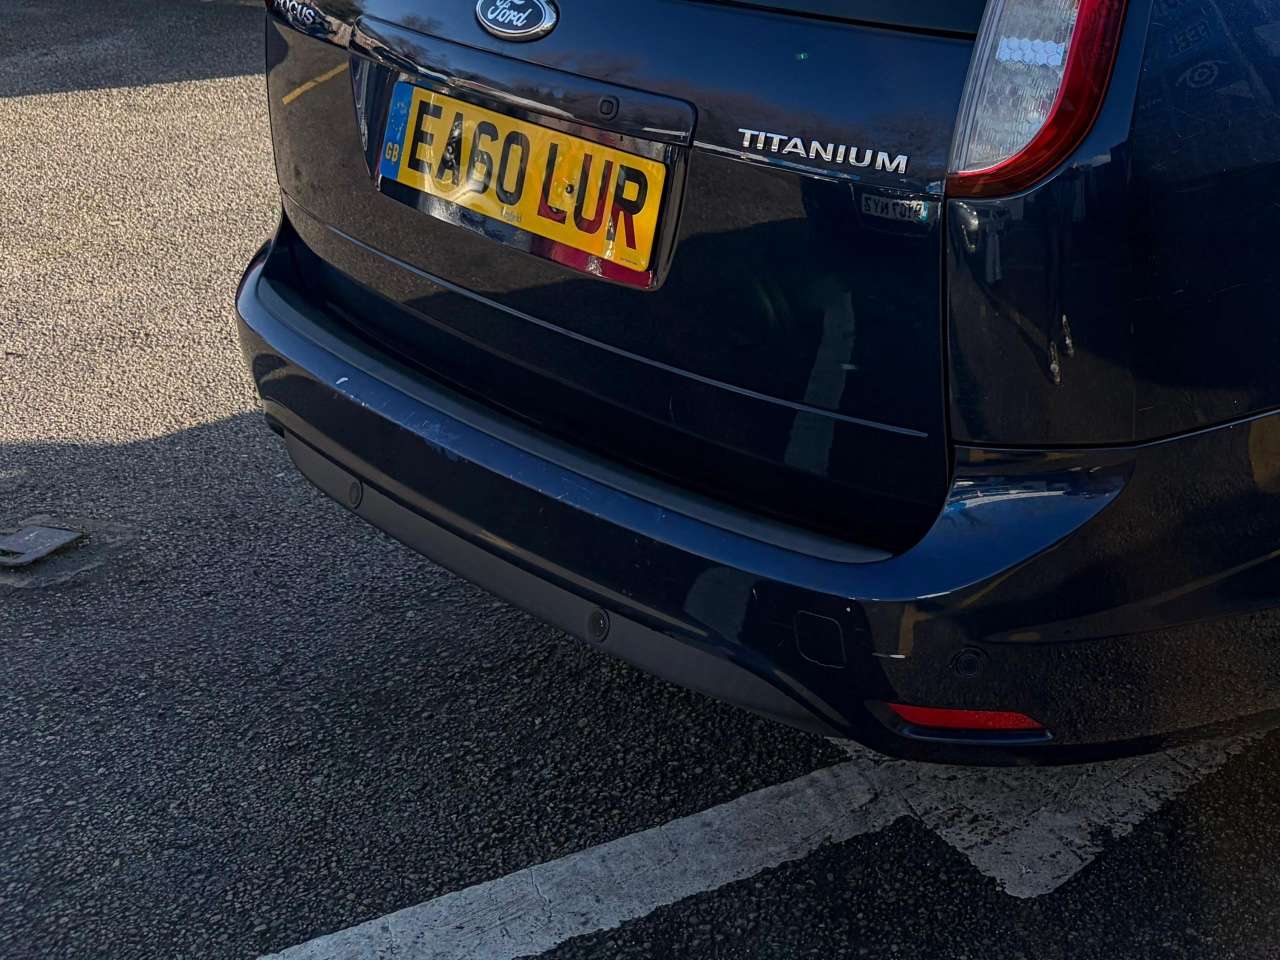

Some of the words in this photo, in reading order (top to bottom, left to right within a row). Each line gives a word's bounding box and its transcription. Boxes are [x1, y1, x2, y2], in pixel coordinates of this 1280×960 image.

[385, 141, 399, 164] GB
[738, 128, 908, 174] TITANIUM
[407, 100, 531, 206] EA60
[537, 142, 649, 250] LUR
